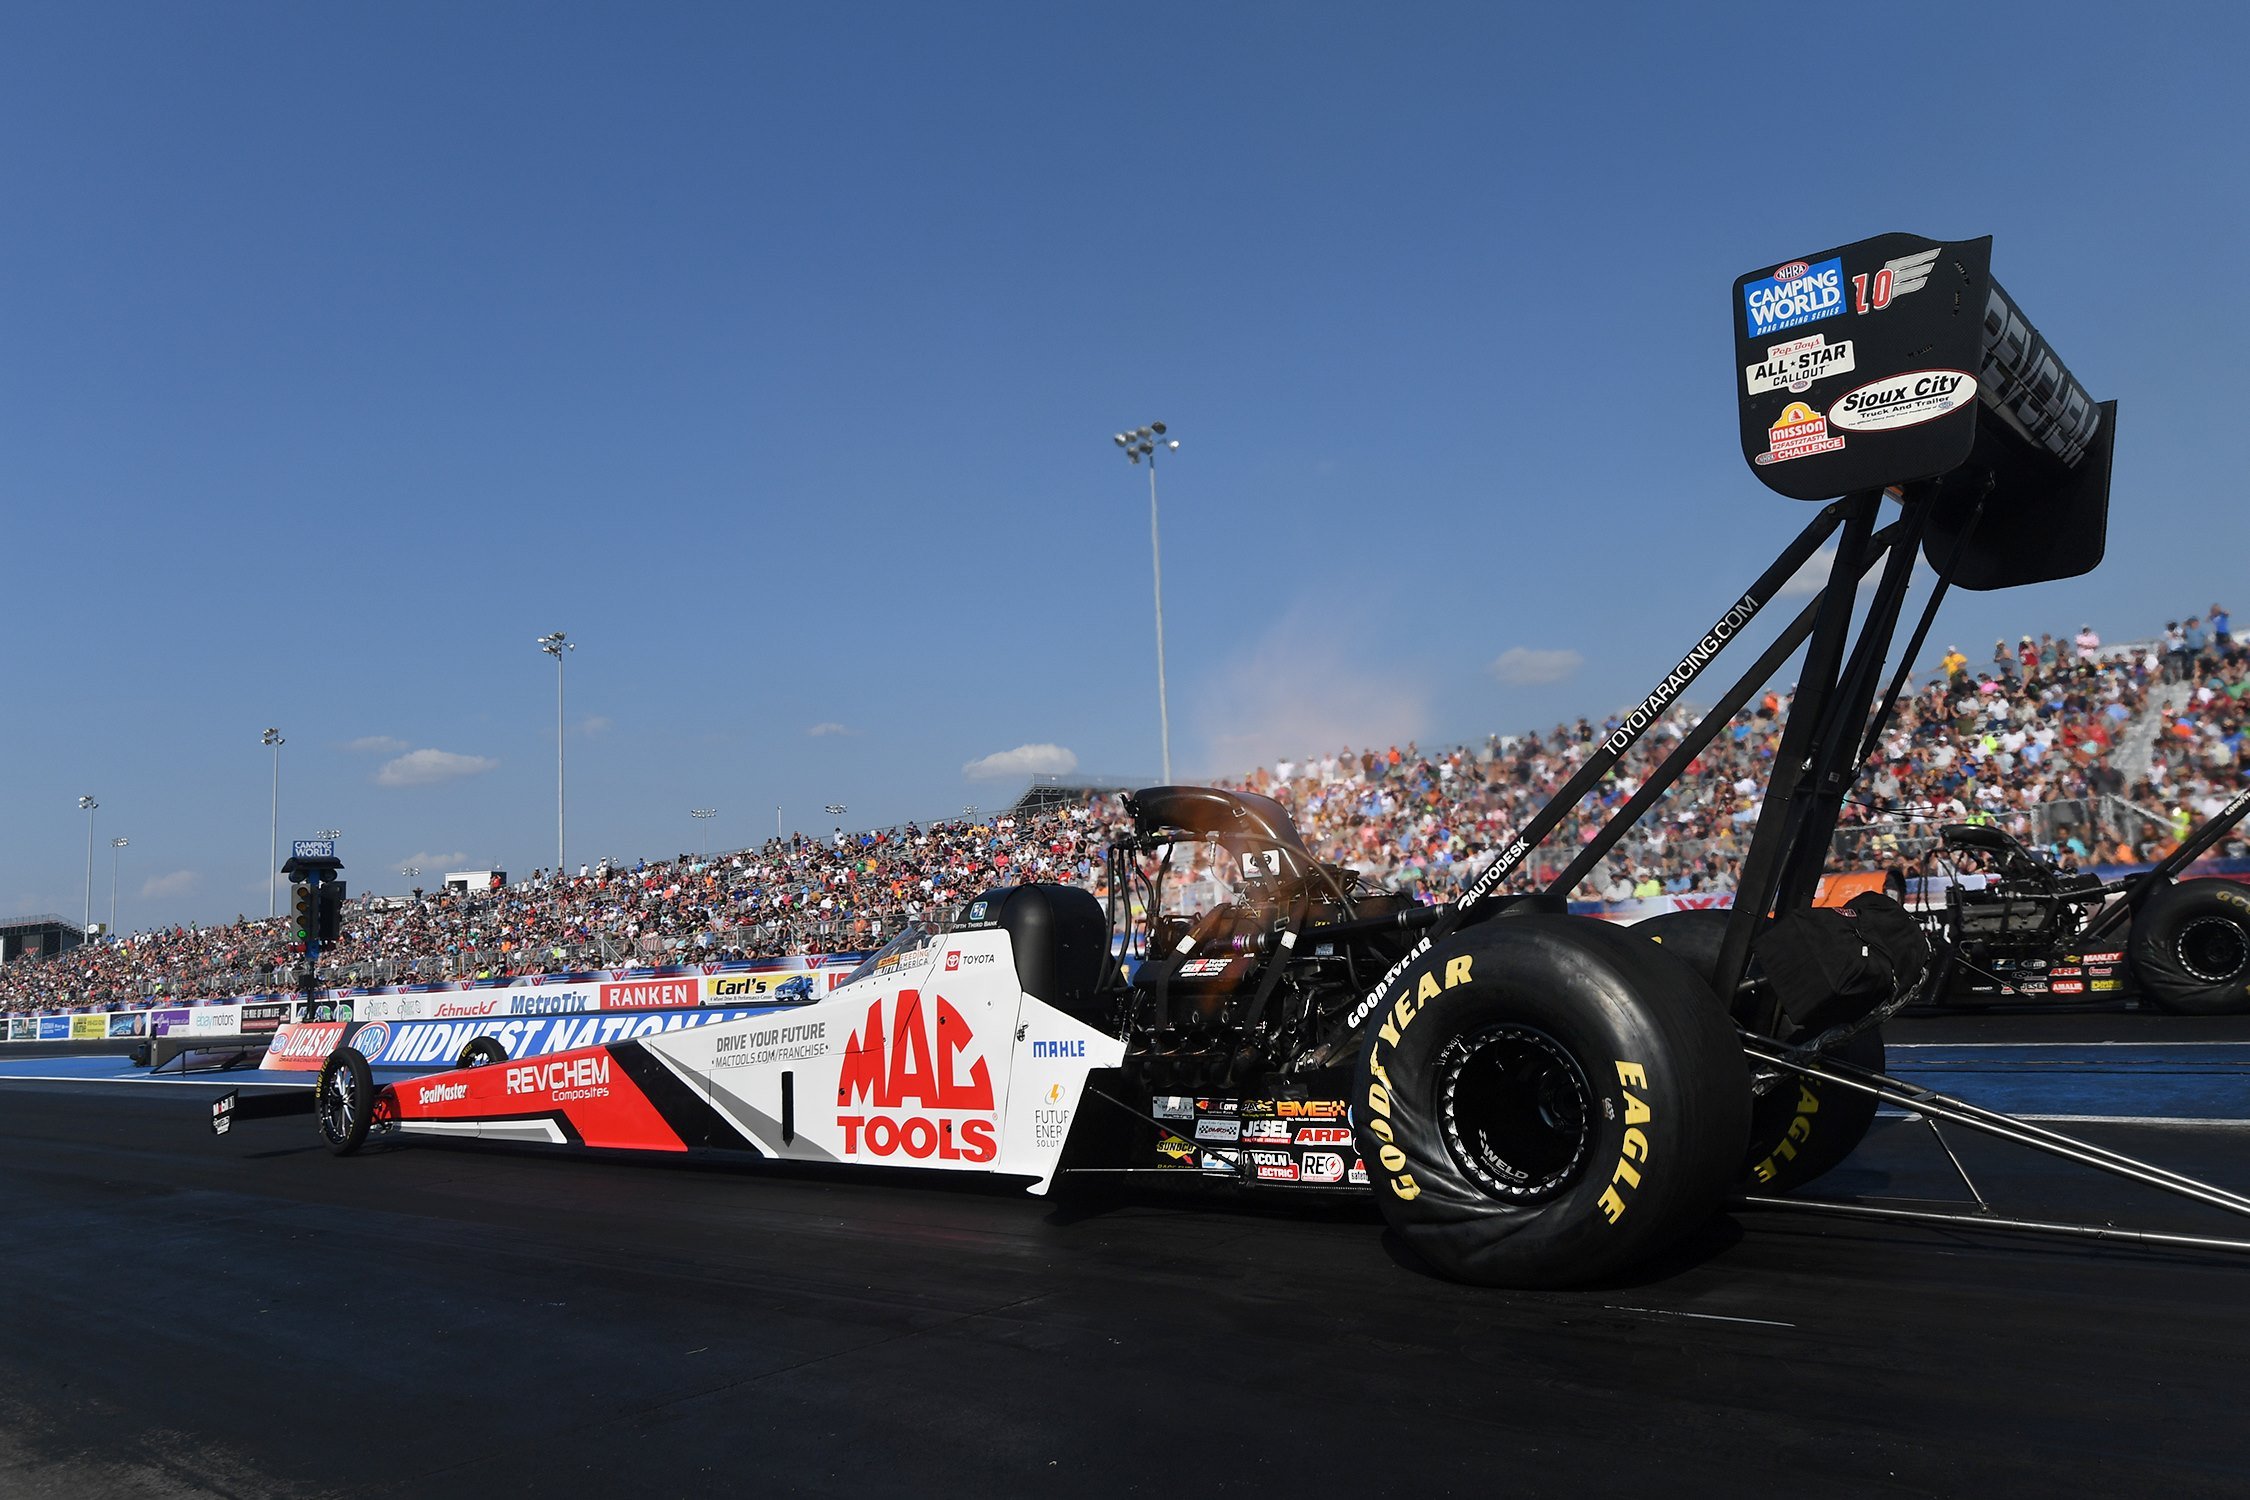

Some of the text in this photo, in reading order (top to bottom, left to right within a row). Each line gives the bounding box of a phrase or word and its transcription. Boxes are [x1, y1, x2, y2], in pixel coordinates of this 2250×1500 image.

[1778, 264, 1805, 279] NHRA
[1749, 270, 1838, 308] CAMPING
[1852, 269, 1894, 315] 10
[1750, 289, 1840, 326] WORLD
[1756, 307, 1840, 336] DRAG RACING SERIES
[1772, 338, 1820, 356] Pep Boys
[1755, 344, 1847, 380] ALL STAR
[1772, 366, 1826, 387] CALLOUT
[1843, 375, 1963, 412] Sioux City
[1860, 409, 1889, 419] Truck
[1892, 403, 1912, 412] And
[1914, 396, 1950, 408] Trailer
[1777, 438, 1842, 459] CHALLENGE
[1602, 595, 1758, 756] TOYOTARACING.COM
[294, 841, 333, 849] CAMPING
[295, 848, 332, 857] WORLD
[1467, 836, 1530, 902] AUTODESK
[898, 957, 929, 970] AMERICA
[900, 950, 929, 961] FEEDING
[963, 954, 995, 965] TOYOTA
[2083, 953, 2119, 962] MANLEY
[716, 978, 767, 995] Carl's
[1347, 936, 1433, 1029] GOODYEAR
[2022, 982, 2047, 990] JESEL
[510, 991, 588, 1015] MetroTix
[609, 985, 688, 1007] RANKEN
[271, 1007, 280, 1017] LIFE
[434, 1000, 498, 1017] Schnucks
[196, 1013, 212, 1030] ebay
[213, 1013, 234, 1026] motors
[283, 1028, 324, 1057] LUCAS
[316, 1027, 343, 1057] OIL
[352, 1028, 385, 1058] NHRA
[539, 1012, 748, 1056] NATIO
[716, 1022, 826, 1052] DRIVE YOUR FUTURE
[715, 1043, 825, 1068] MACTOOLS.COM/FRANCHISE
[837, 989, 995, 1111] MAC
[1033, 1040, 1085, 1058] MAHLE
[506, 1056, 610, 1095] REVCHEM
[1368, 954, 1473, 1201] GOODYEAR
[419, 1083, 468, 1105] SealMaster
[552, 1086, 610, 1102] Composites
[1277, 1100, 1331, 1117] BME
[836, 1115, 998, 1163] TOOLS
[1242, 1120, 1292, 1139] JESEL
[1296, 1129, 1350, 1142] ARP
[1157, 1141, 1195, 1153] SUNOCO
[1596, 1060, 1651, 1225] EAGLE
[1244, 1151, 1287, 1166] LNCOLN
[1483, 1143, 1529, 1179] WELD
[1257, 1167, 1294, 1178] LECTRIC
